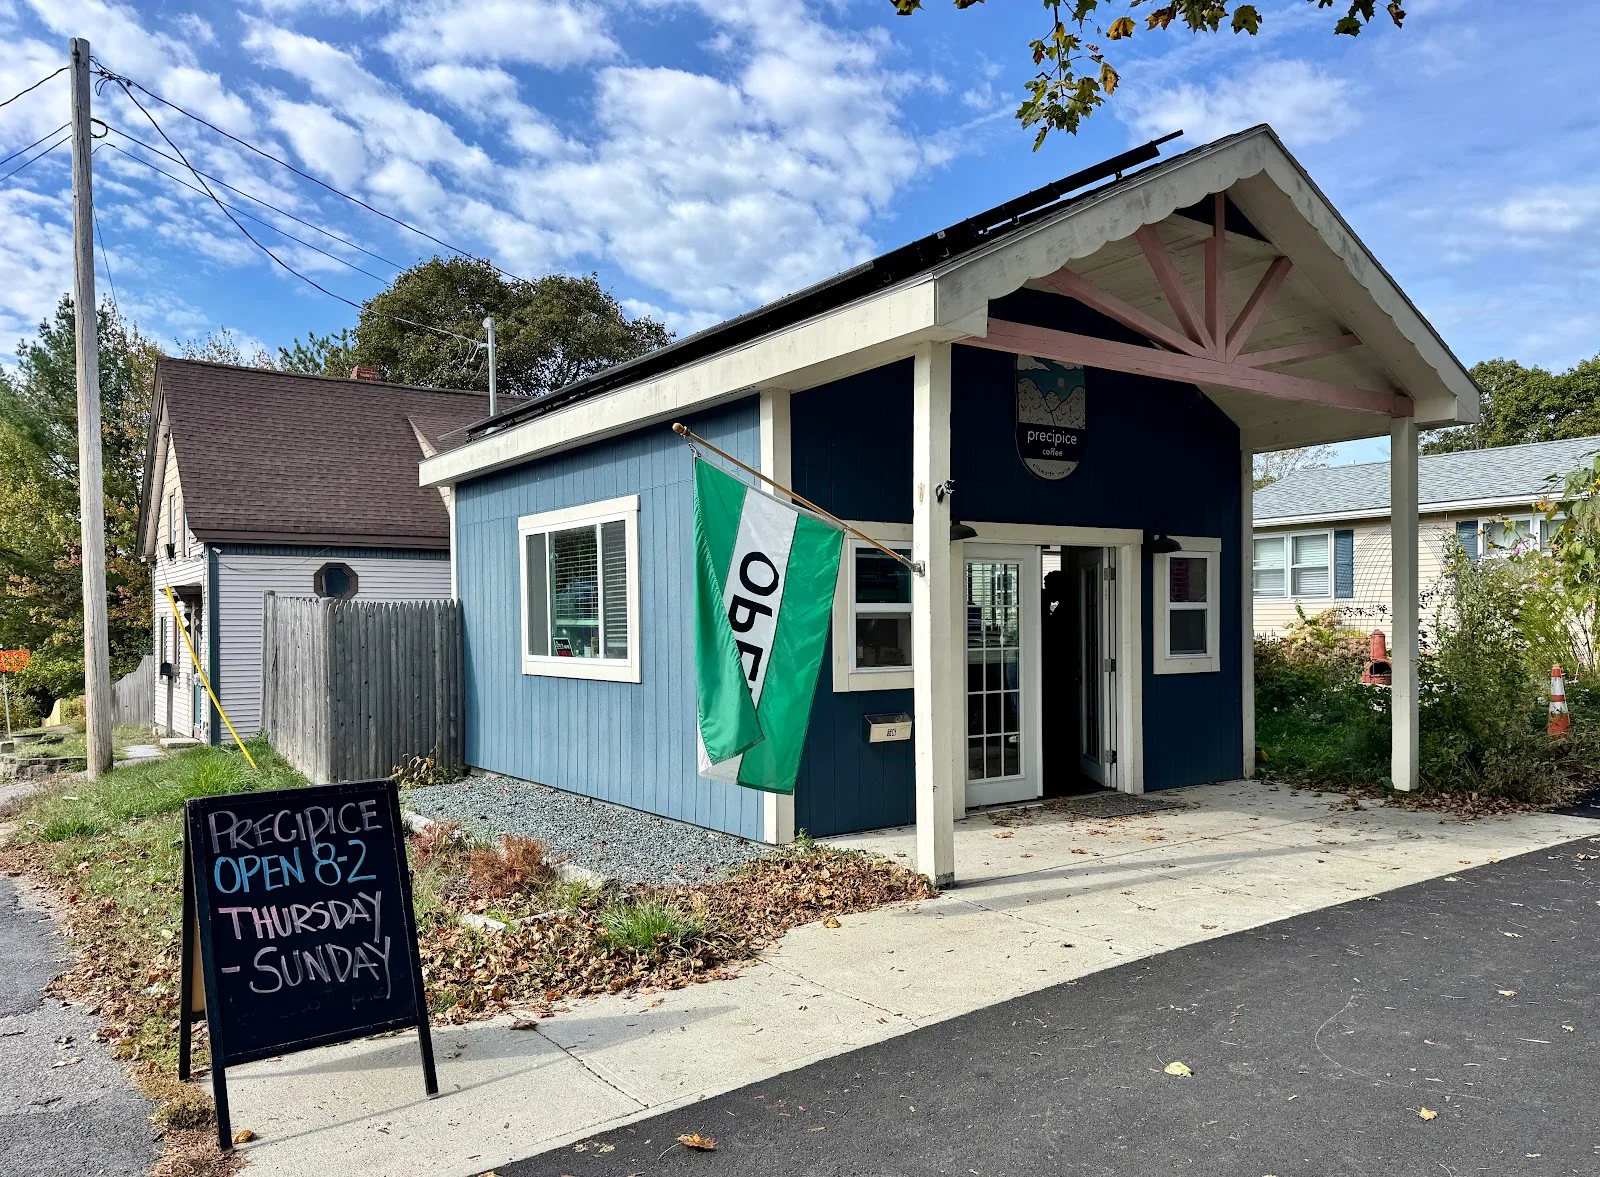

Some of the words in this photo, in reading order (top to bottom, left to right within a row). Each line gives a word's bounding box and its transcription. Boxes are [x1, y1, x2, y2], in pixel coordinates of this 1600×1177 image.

[1027, 430, 1077, 446] precipice
[1042, 448, 1063, 457] coffee
[208, 800, 382, 853] PRECIPICE
[214, 847, 305, 894] OPEN
[314, 839, 377, 886] 8-2
[218, 890, 382, 943] THURSDAY
[249, 936, 391, 999] SUNDAY
